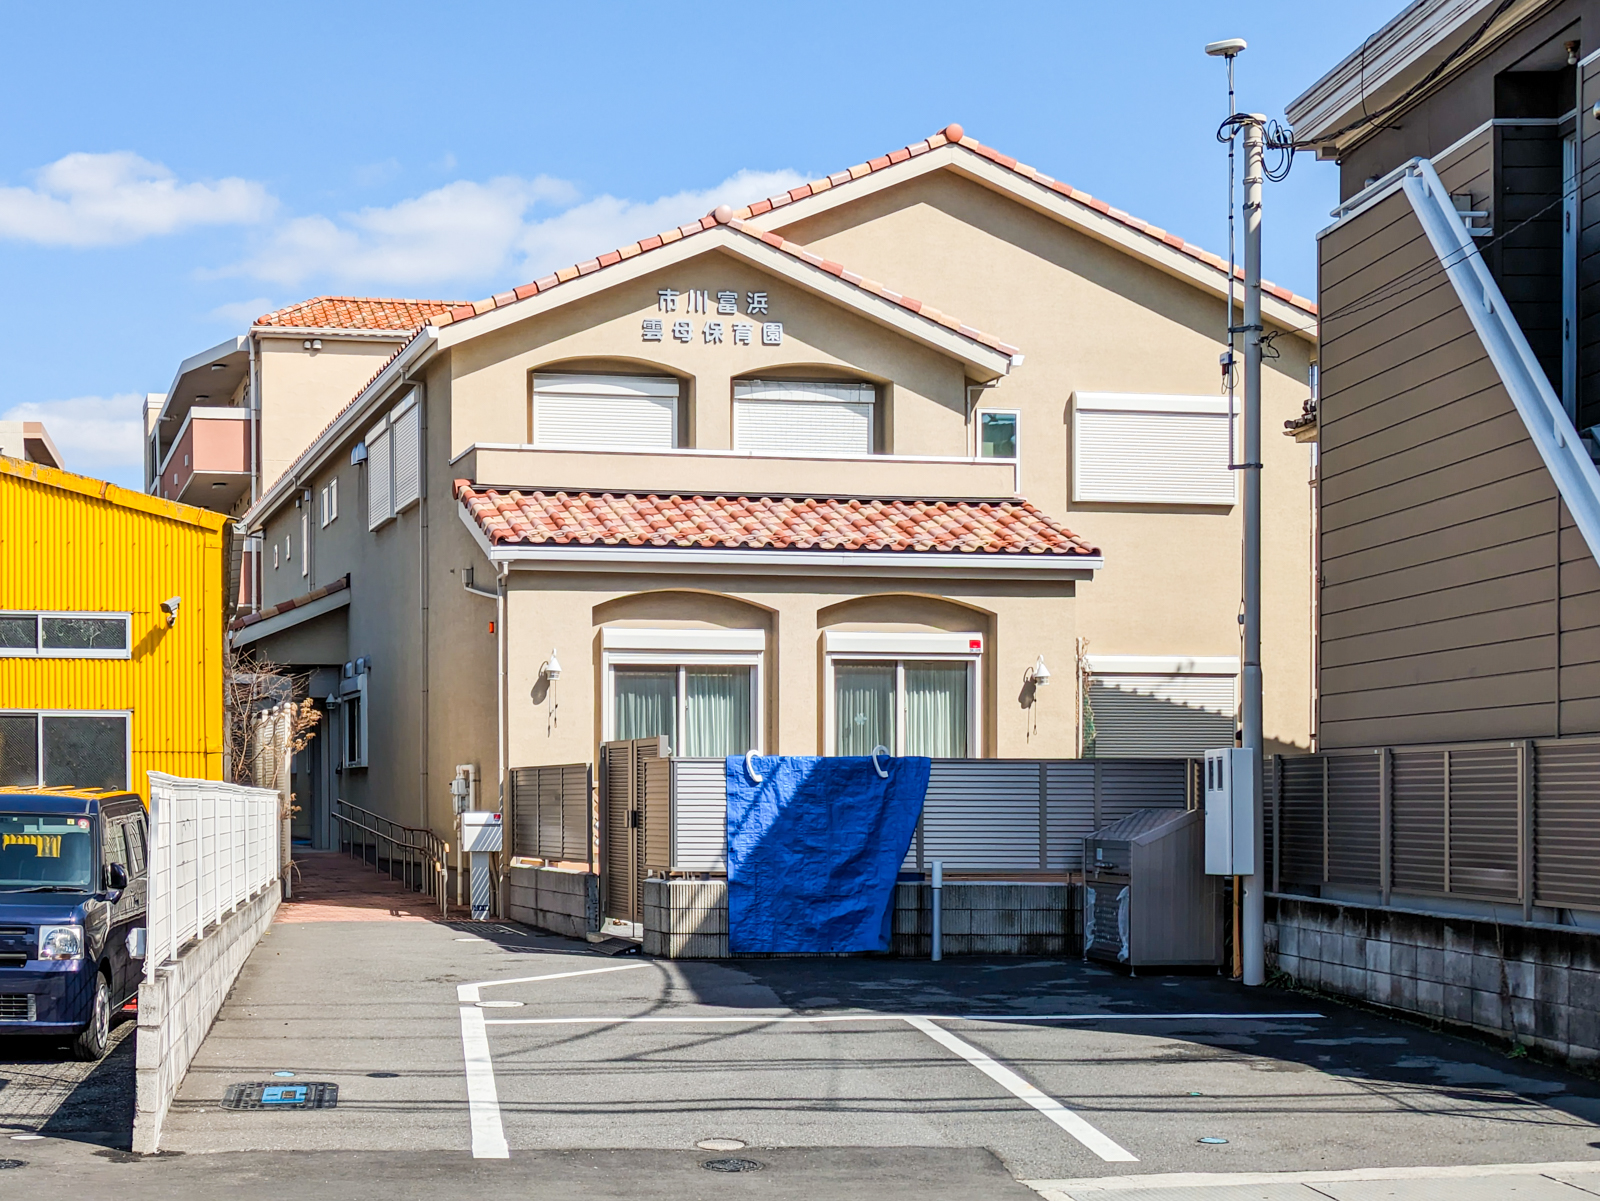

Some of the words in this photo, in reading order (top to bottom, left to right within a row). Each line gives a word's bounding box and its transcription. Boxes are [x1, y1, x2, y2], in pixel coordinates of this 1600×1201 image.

[658, 288, 768, 315] 市川富浜
[642, 319, 784, 345] 雲母保育園
